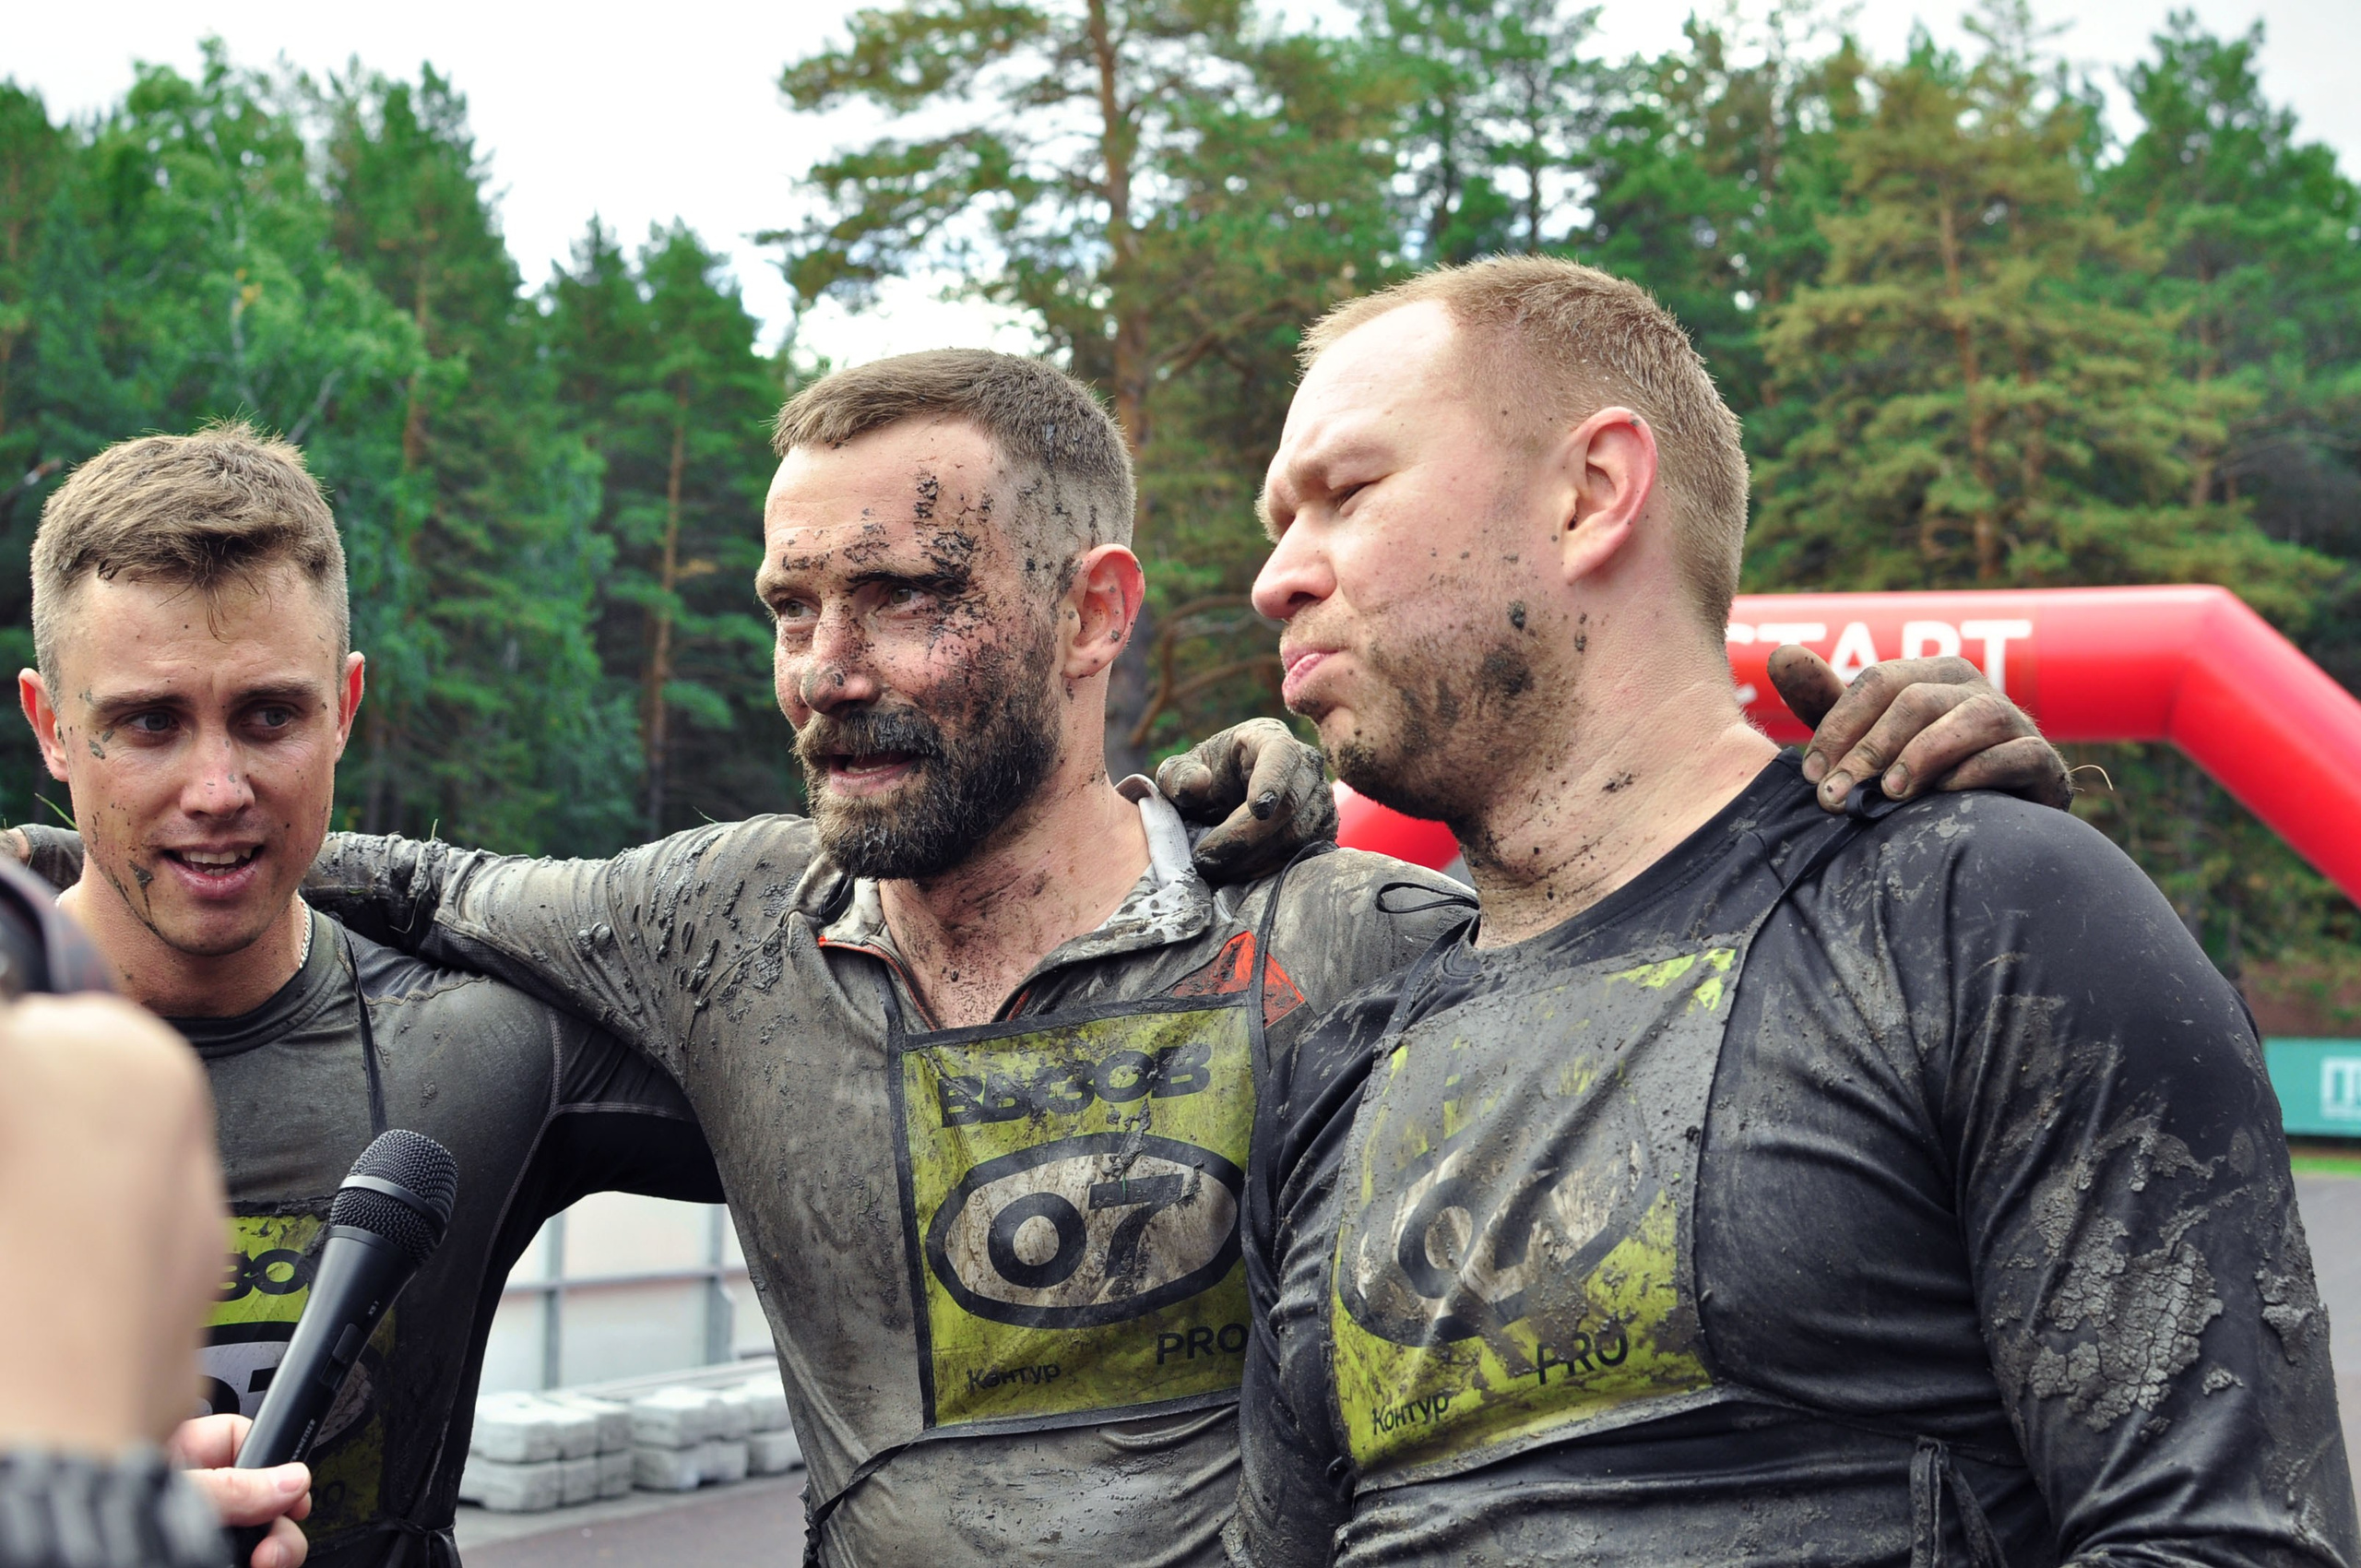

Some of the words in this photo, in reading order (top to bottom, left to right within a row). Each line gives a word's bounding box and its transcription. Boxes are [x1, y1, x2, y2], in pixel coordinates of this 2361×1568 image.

[988, 1174, 1185, 1289] 07
[1157, 1324, 1249, 1365] PRO
[1537, 1326, 1629, 1385] PRO
[966, 1361, 1062, 1394] Контур
[1371, 1393, 1451, 1436] Контур
